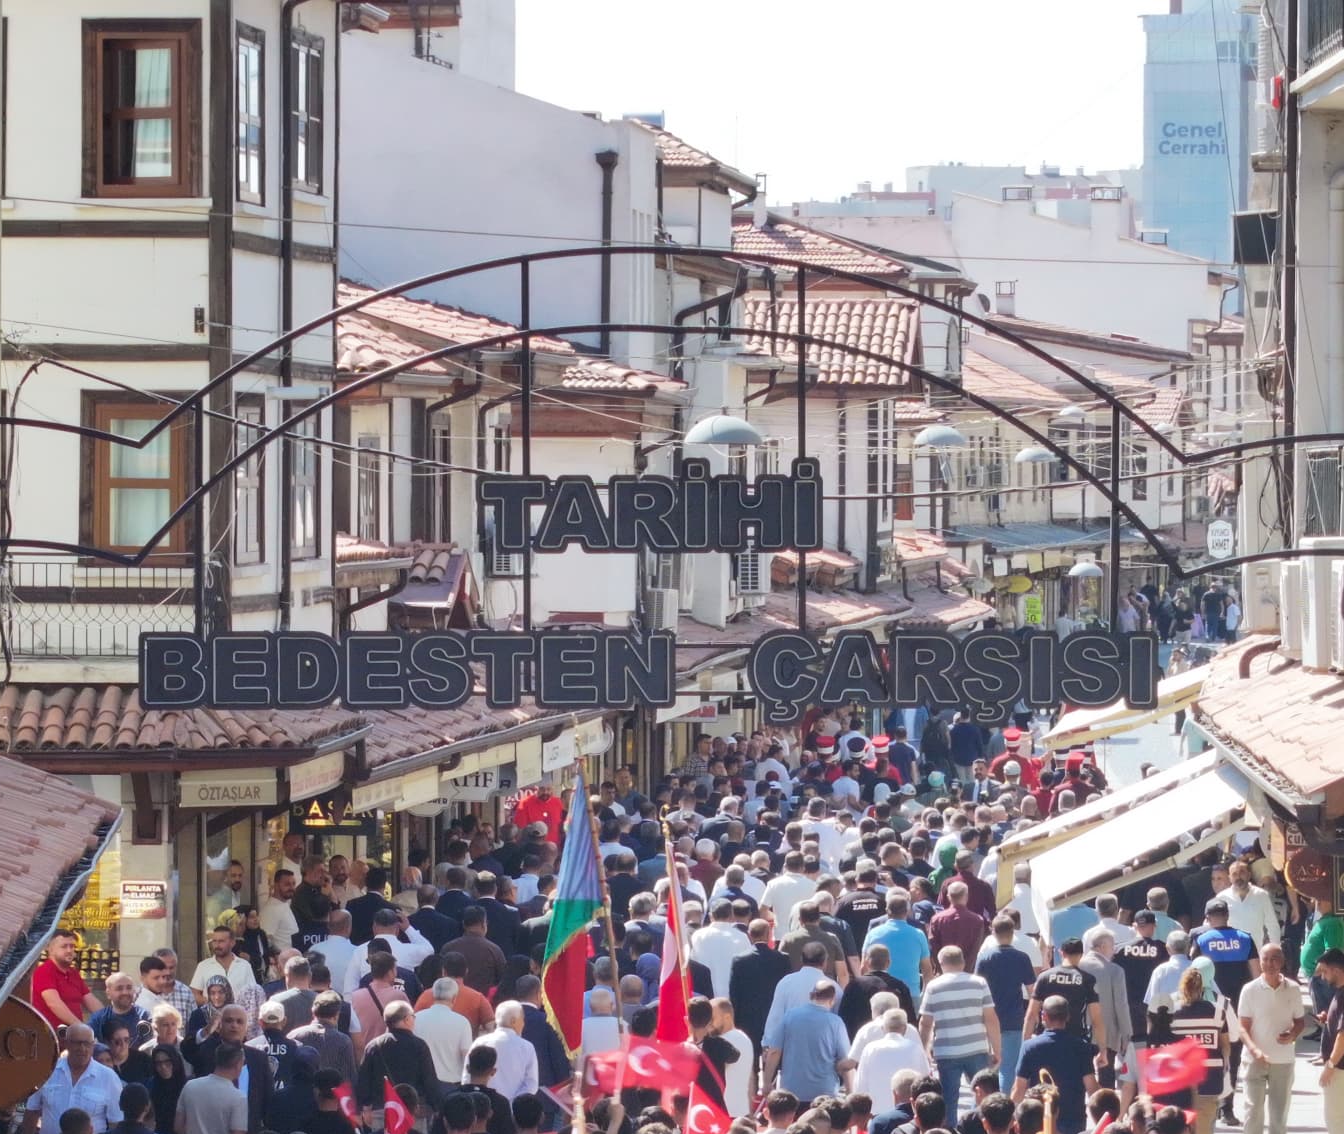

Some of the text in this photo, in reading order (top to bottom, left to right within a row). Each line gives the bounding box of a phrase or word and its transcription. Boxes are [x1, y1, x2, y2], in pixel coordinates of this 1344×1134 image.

[1162, 121, 1222, 137] Genel
[1158, 139, 1226, 155] Cerrahi
[479, 459, 822, 552] TARİHİ
[141, 632, 1157, 723] BEDESTEN ÇARŞISI
[198, 783, 261, 801] ÖZTAŞLAR
